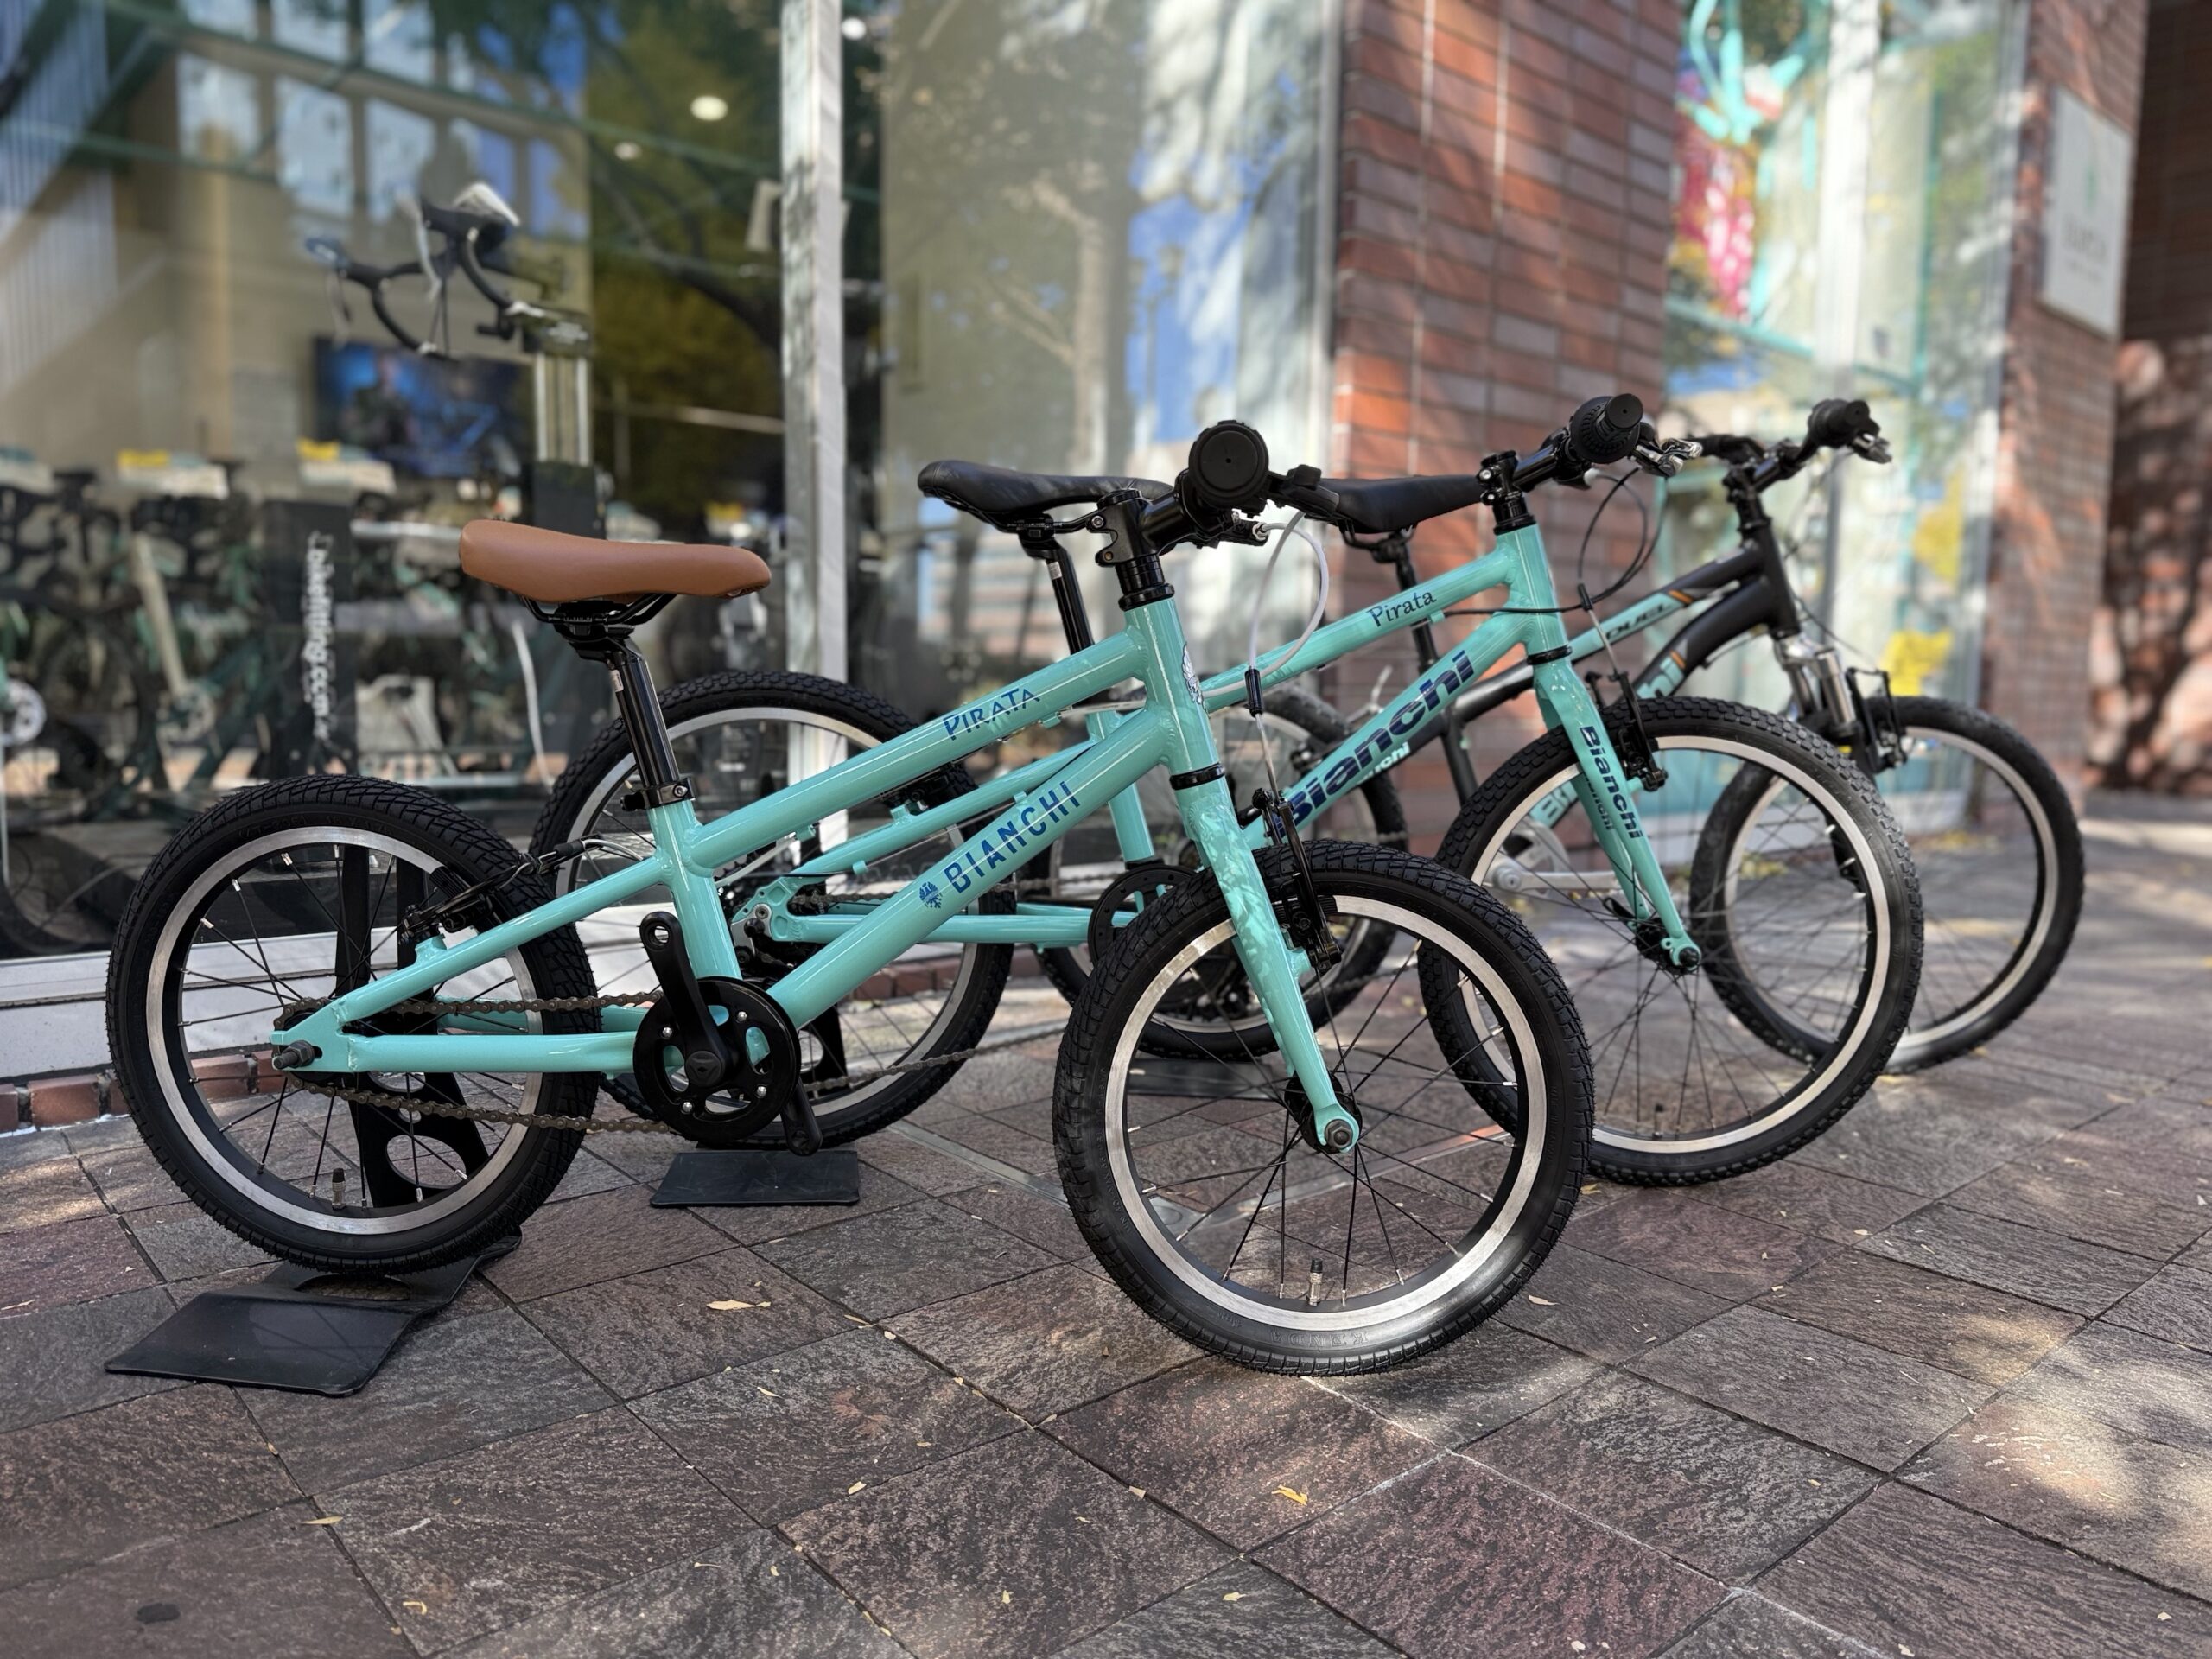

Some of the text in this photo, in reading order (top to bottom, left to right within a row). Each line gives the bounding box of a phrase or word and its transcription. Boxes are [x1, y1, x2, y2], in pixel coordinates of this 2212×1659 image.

[1365, 591, 1437, 627] Pirata
[943, 688, 1040, 741] PIRATA
[1580, 726, 1643, 839] Bianchi
[944, 781, 1080, 893] BIANCHI
